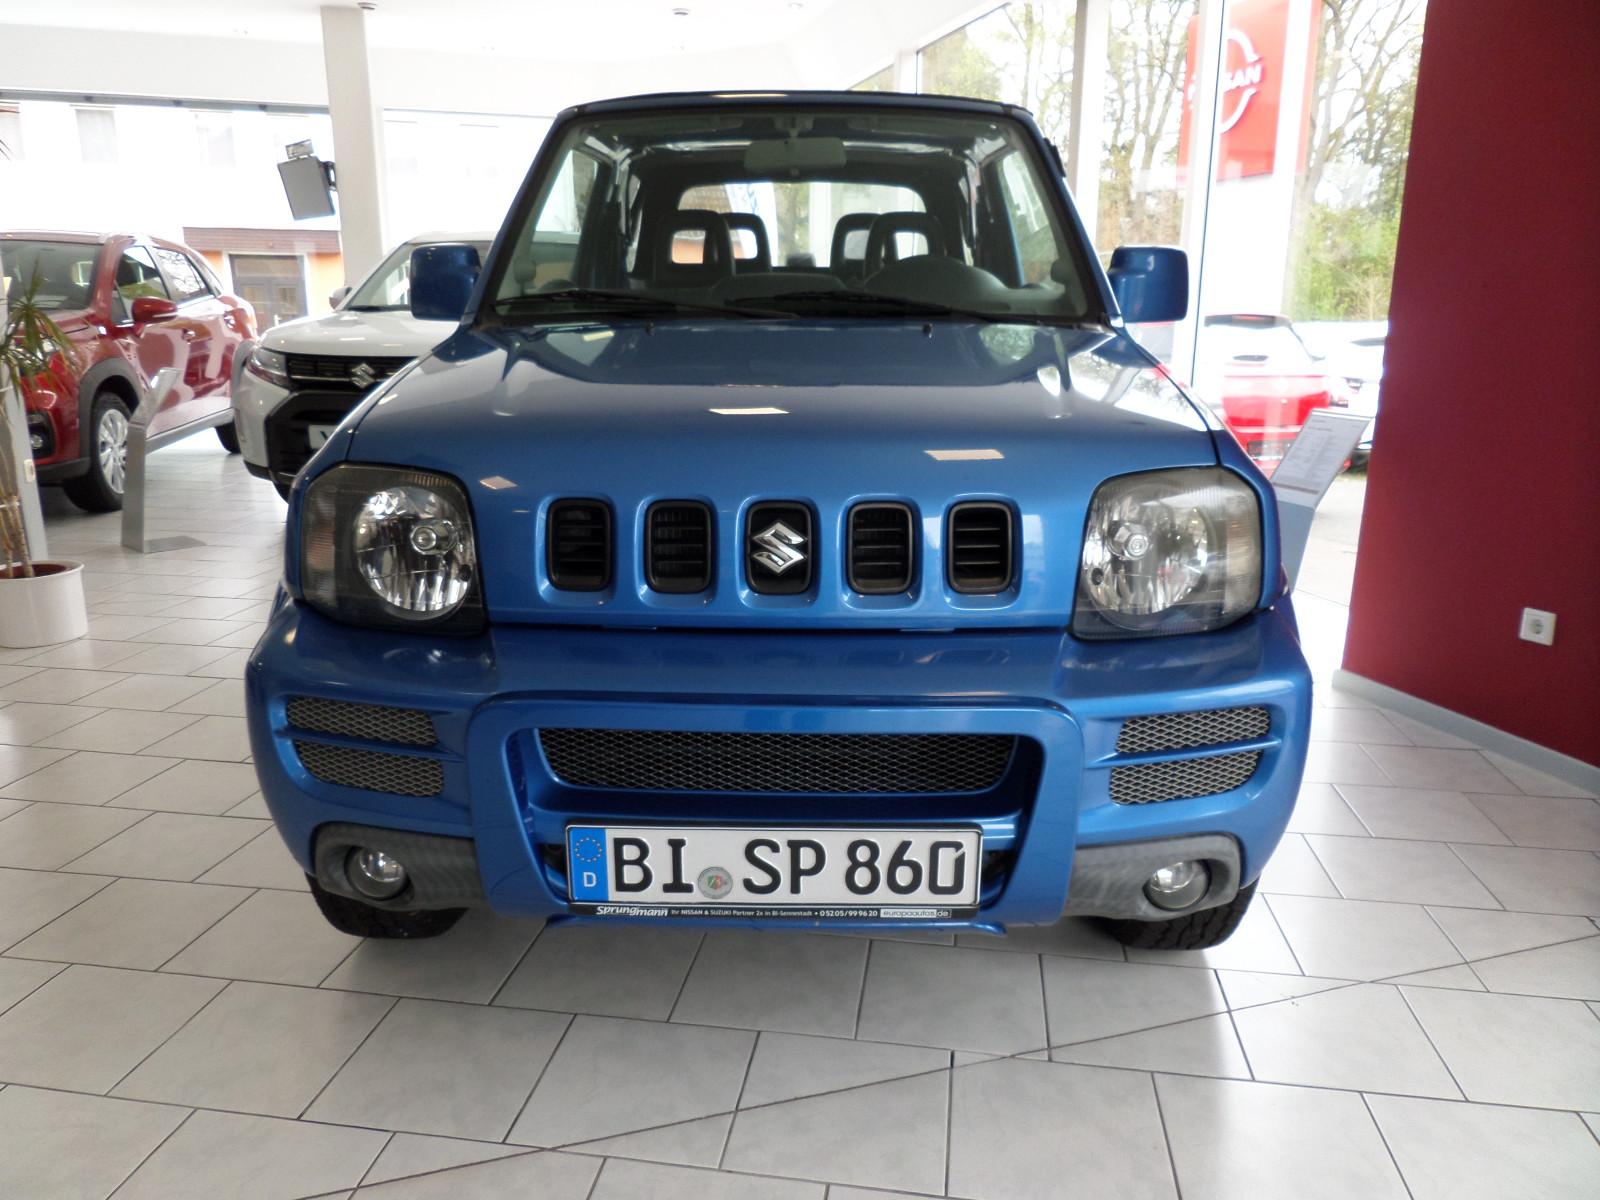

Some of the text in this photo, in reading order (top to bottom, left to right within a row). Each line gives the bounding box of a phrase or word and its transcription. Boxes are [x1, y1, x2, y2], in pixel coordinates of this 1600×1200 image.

[613, 837, 694, 893] BI
[743, 838, 826, 894] SP
[845, 839, 965, 895] 860
[583, 872, 597, 888] D
[596, 905, 669, 917] Sprungmann
